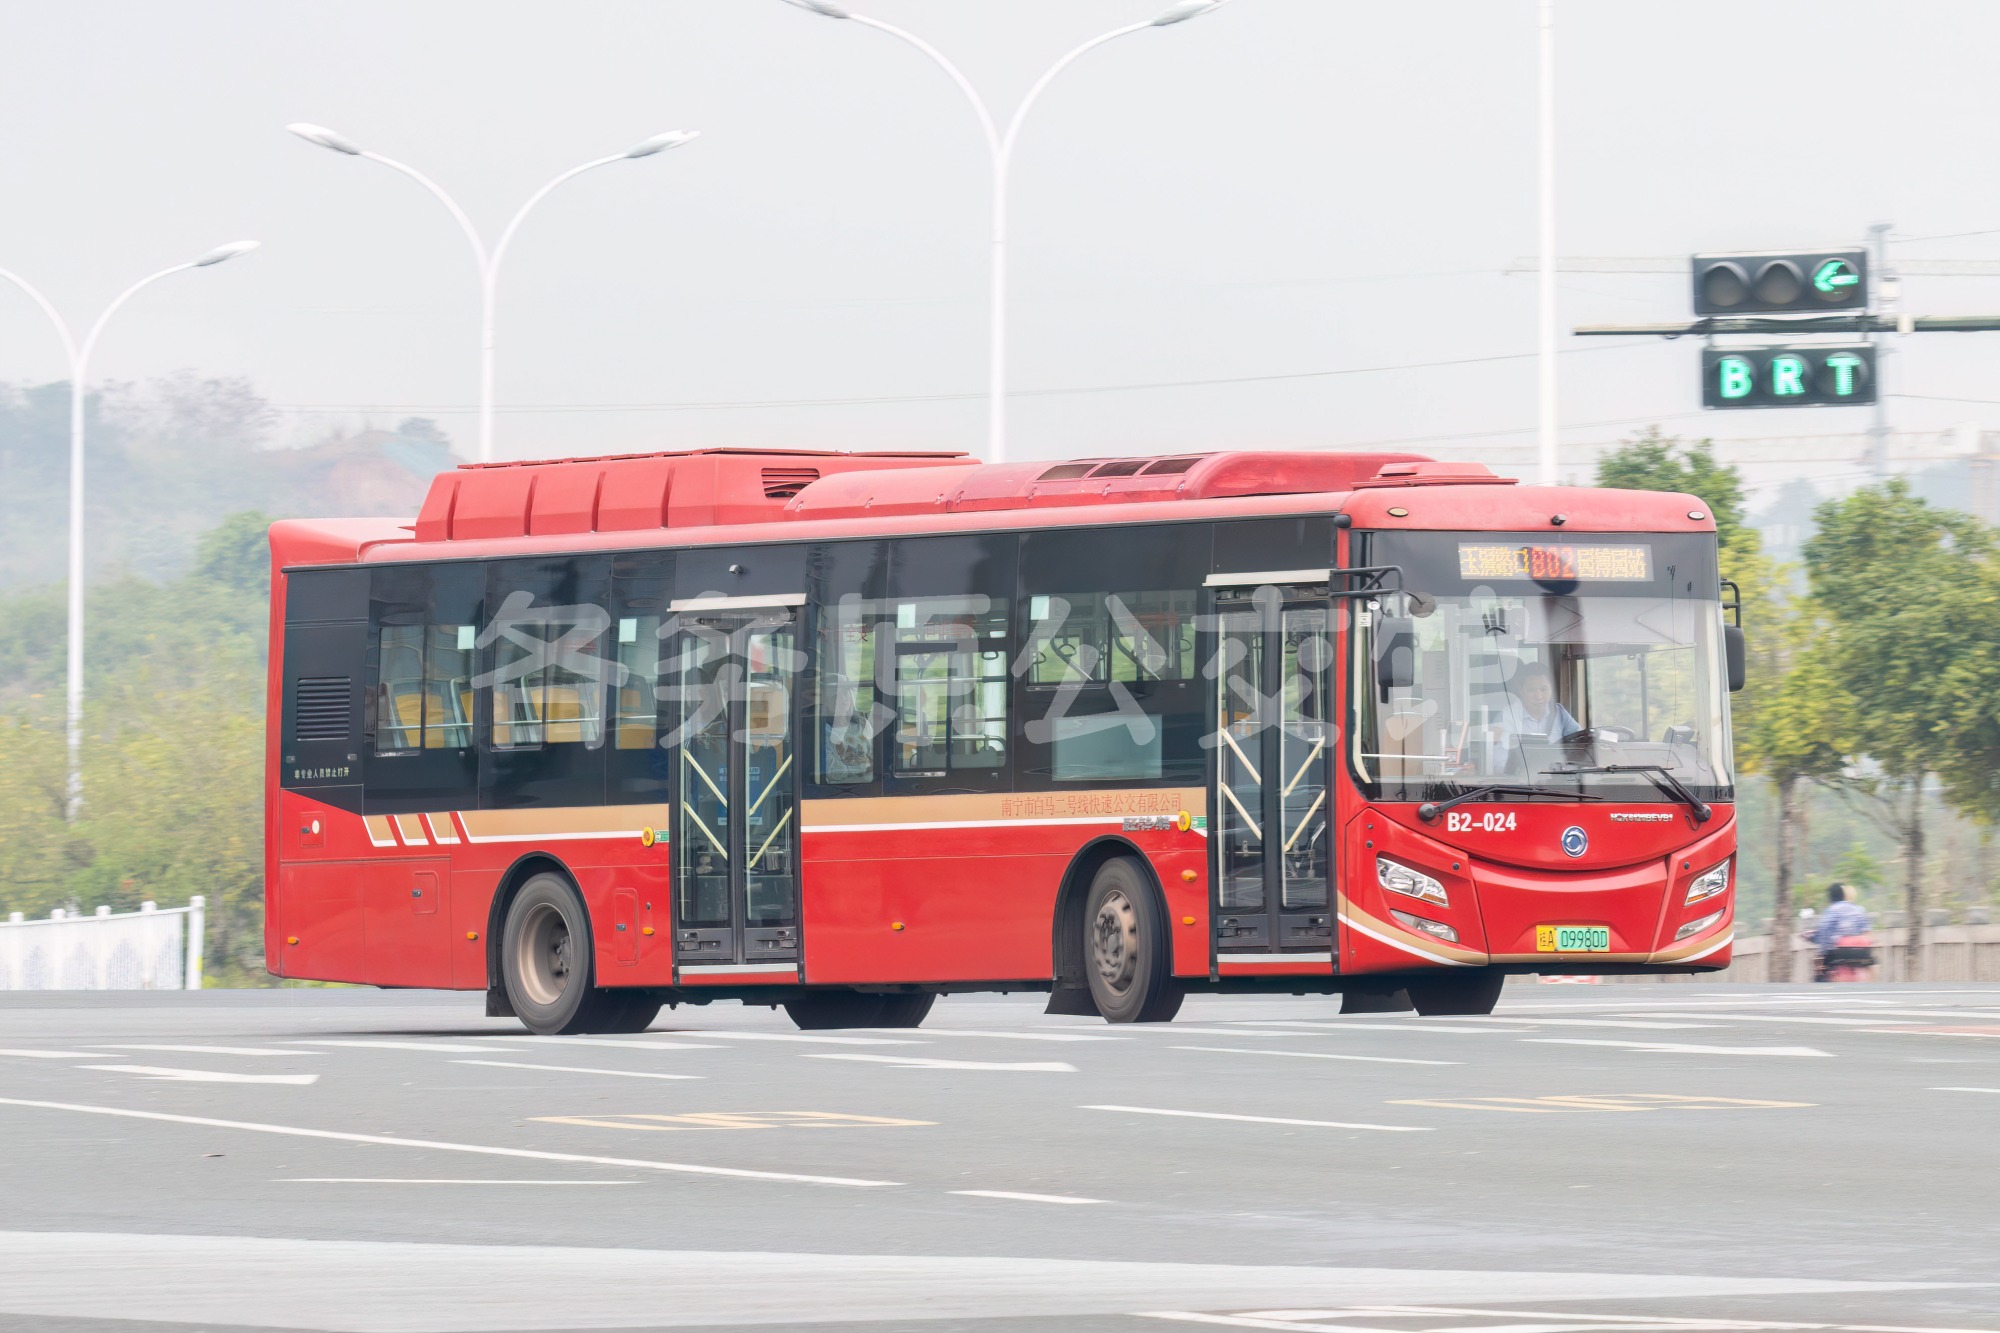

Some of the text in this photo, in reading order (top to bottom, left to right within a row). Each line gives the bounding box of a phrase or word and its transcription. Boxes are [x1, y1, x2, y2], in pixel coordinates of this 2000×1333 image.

[1720, 357, 1860, 398] BRT
[1531, 546, 1575, 579] B02
[1001, 793, 1183, 817] 南宁市白马二号线快速公交有限公司
[1446, 812, 1517, 832] B2-024
[1561, 930, 1608, 948] 09980D
